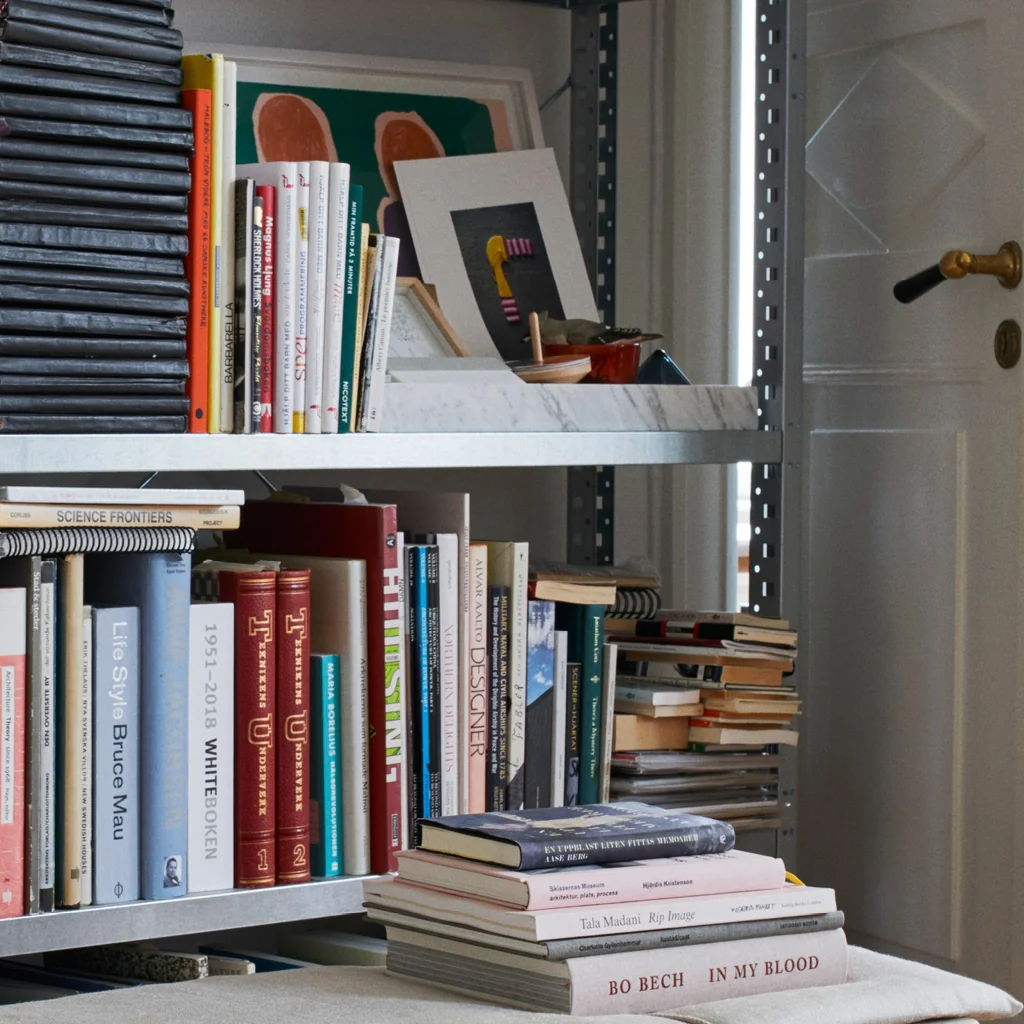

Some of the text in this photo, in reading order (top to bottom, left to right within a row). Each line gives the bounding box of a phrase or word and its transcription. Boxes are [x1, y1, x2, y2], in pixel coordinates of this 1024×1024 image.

[199, 153, 210, 276] TEGN MED DANSKE
[252, 229, 261, 274] SHERLOCK
[261, 215, 274, 296] Magnus Ljung
[335, 232, 343, 259] BARN
[345, 200, 358, 295] MIN FRAMTID PÅ MINUTER
[297, 250, 307, 335] PROGRAMMERING
[224, 301, 233, 383] BARBARELLA
[283, 319, 291, 340] MED
[282, 372, 290, 393] DITT
[374, 351, 383, 372] Albert
[340, 380, 349, 423] NICOTEXT
[56, 510, 173, 523] SCIENCE FRONTIERS
[32, 571, 40, 630] Stad steder
[470, 557, 487, 759] ALVAR AALTO DESIGNER
[499, 633, 507, 658] NAVAL
[43, 675, 50, 686] BY
[499, 664, 507, 676] AND
[3, 669, 12, 764] Architecture Theory since
[325, 661, 337, 757] MARIA BORELIUS
[443, 623, 454, 773] NORTHERN DELIGHTS
[108, 621, 127, 842] Life Style Bruce Mau
[203, 738, 219, 861] WHITEBOKEN
[257, 848, 269, 871] 1
[293, 844, 306, 867] 2
[543, 837, 656, 854] EN LITEN FITTAS
[549, 881, 606, 893] Skissernas Museum
[596, 890, 619, 898] process
[578, 908, 696, 929] Tala Madani Rip Image
[607, 954, 820, 996] BO BECH IN MY BLOOD
